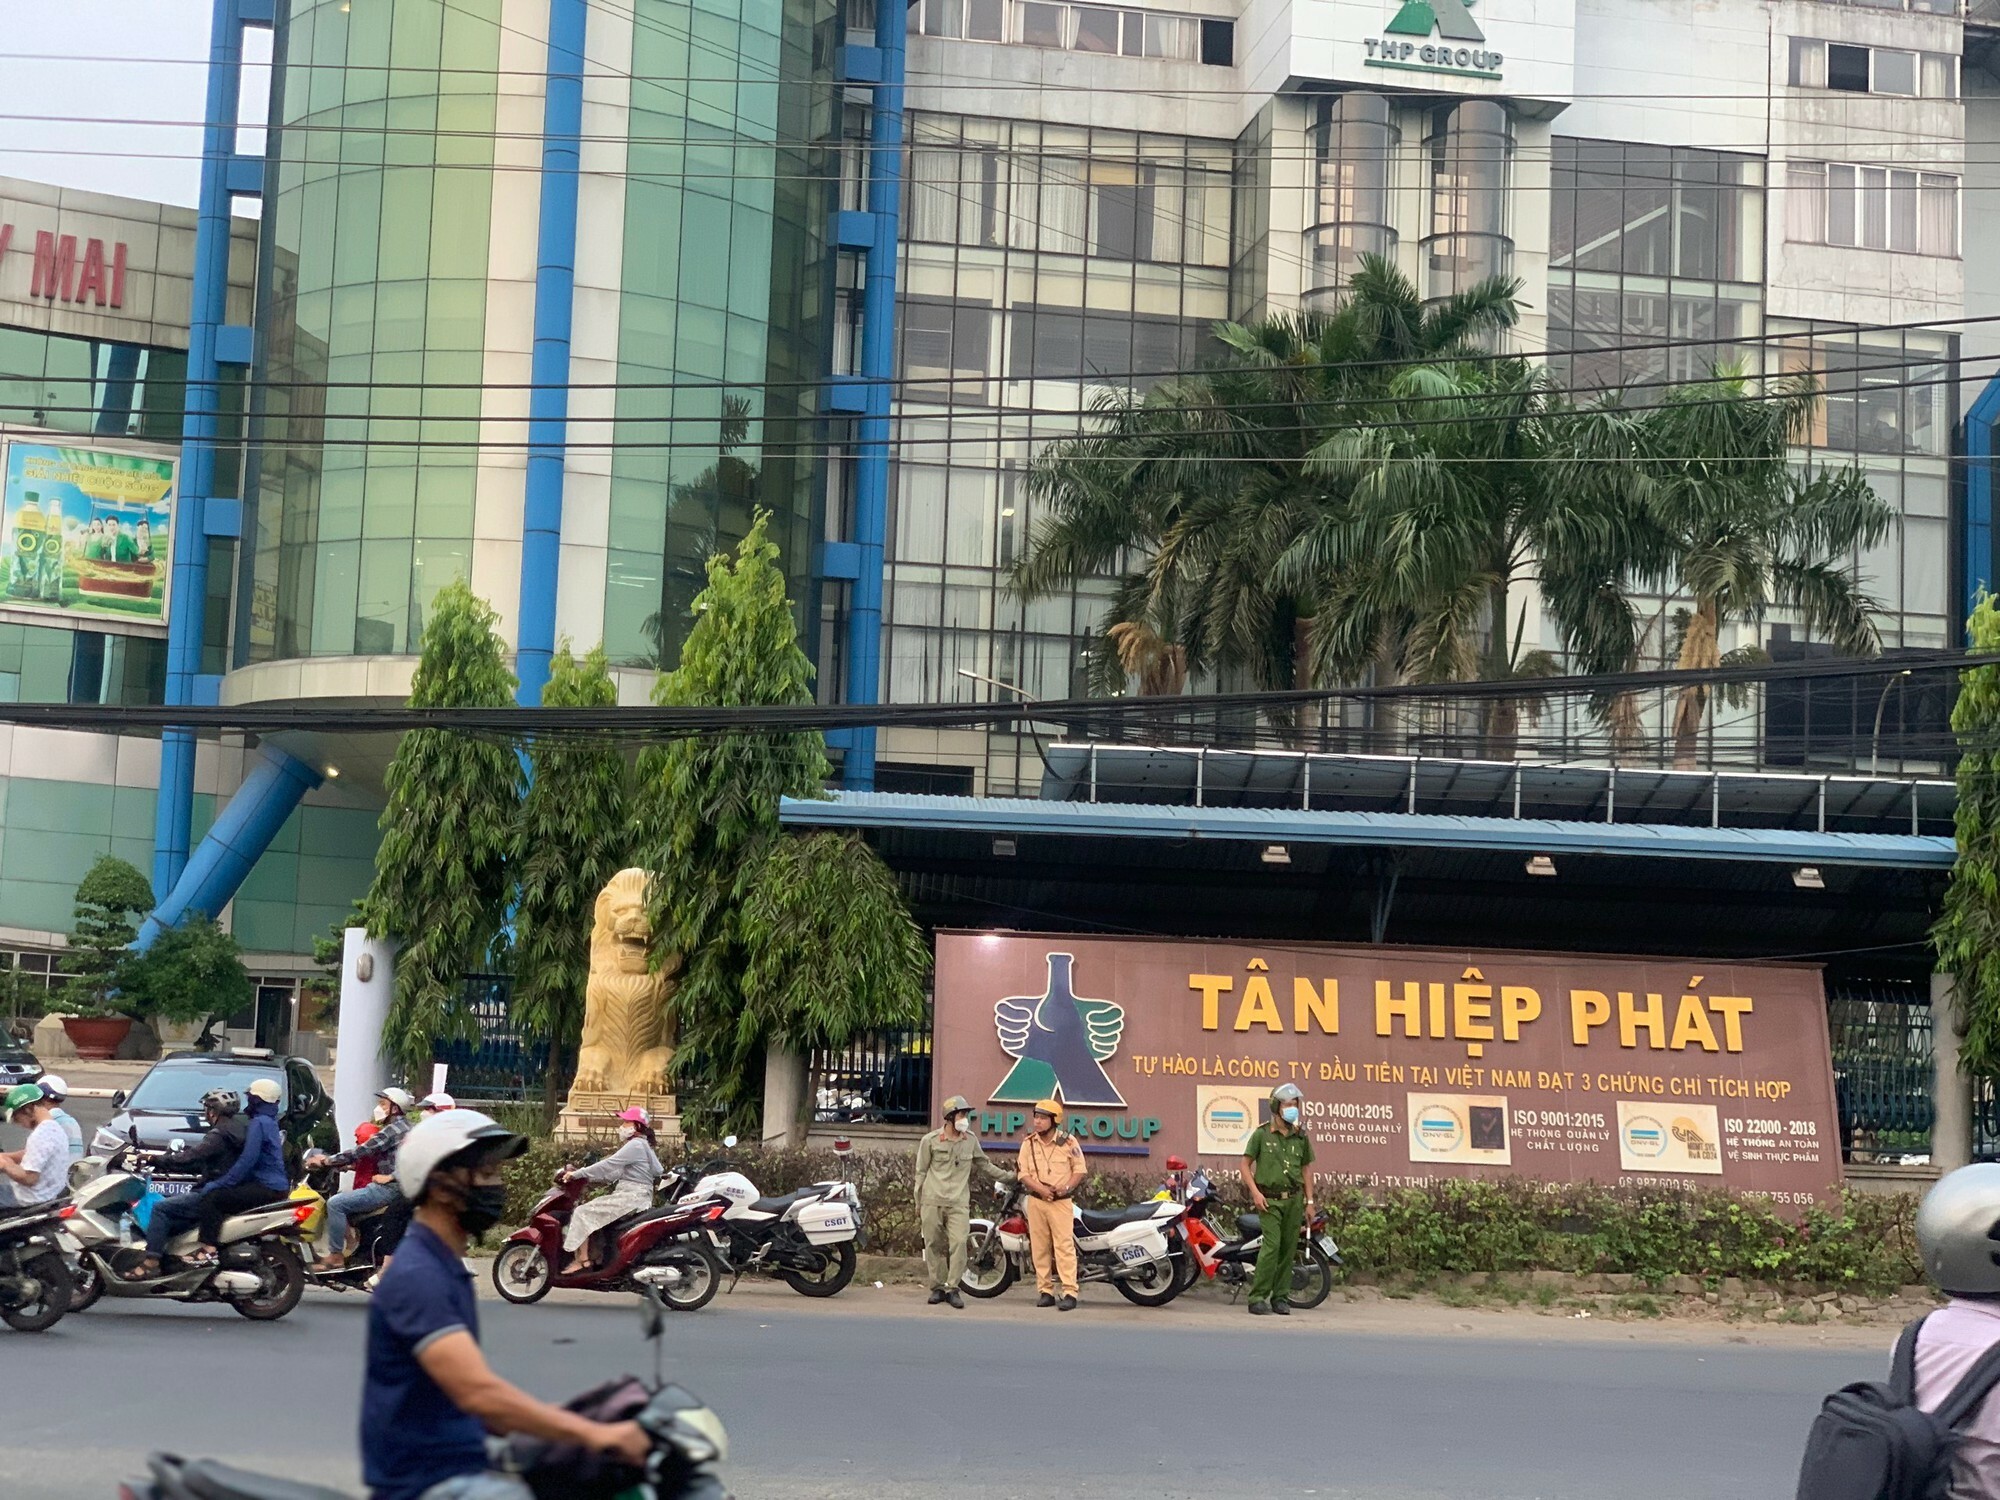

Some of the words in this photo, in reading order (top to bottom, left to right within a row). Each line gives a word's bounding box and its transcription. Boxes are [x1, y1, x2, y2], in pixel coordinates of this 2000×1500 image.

[1364, 38, 1414, 60] THP
[1419, 44, 1503, 70] GROUP
[30, 230, 127, 308] MAI
[1188, 957, 1340, 1034] TÂN
[1374, 967, 1543, 1058] HIỆP
[1570, 976, 1754, 1053] PHÁT
[1132, 1055, 1158, 1078] TỰ
[1162, 1053, 1198, 1076] HÀO
[1202, 1055, 1226, 1077] LÀ
[1227, 1056, 1280, 1079] CÔNG
[1288, 1061, 1313, 1080] TY
[1319, 1055, 1356, 1081] ĐẦU
[1363, 1061, 1404, 1083] TIÊN
[1410, 1065, 1438, 1088] TẠI
[1445, 1063, 1485, 1088] VIỆT
[1491, 1069, 1531, 1089] NAM
[1538, 1071, 1574, 1094] ĐẠT
[1581, 1073, 1591, 1091] 3
[1597, 1070, 1664, 1094] CHỨNG
[1707, 1074, 1749, 1098] TÍCH
[1754, 1080, 1792, 1103] HỢP
[1302, 1101, 1325, 1117] ISO
[1327, 1104, 1393, 1120] 14001:2015
[1514, 1110, 1538, 1126] ISO
[1540, 1112, 1605, 1129] 9001:2015
[1724, 1118, 1744, 1134] ISO
[1527, 1137, 1555, 1151] CHẤT
[1726, 1136, 1740, 1148] HỆ
[1743, 1136, 1776, 1148] THỐNG
[1779, 1139, 1792, 1148] AN
[1794, 1138, 1819, 1149] TOÀN
[1728, 1150, 1740, 1162] VỆ
[1742, 1151, 1763, 1162] SINH
[1765, 1152, 1791, 1165] THỰC
[1770, 1191, 1791, 1204] 755
[1793, 1192, 1814, 1205] 056
[825, 1217, 847, 1227] CSGT
[1121, 1247, 1146, 1261] CSGT
